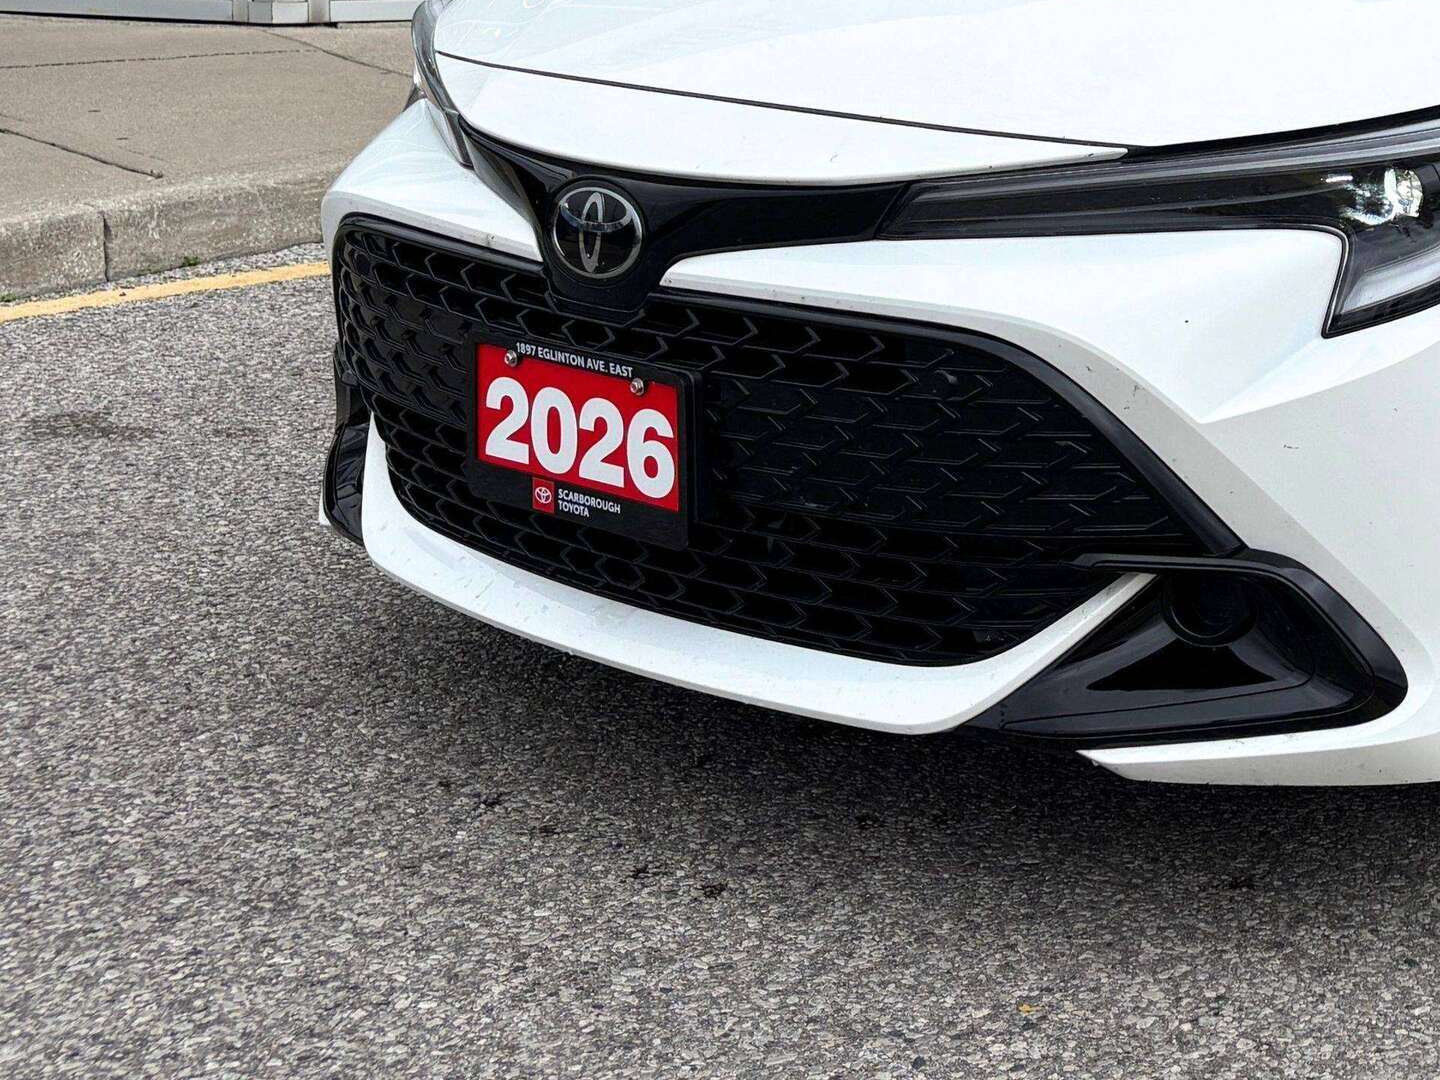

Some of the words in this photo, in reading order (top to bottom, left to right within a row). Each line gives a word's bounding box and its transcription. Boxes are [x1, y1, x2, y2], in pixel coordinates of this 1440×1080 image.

[516, 342, 536, 356] 1897
[537, 347, 585, 368] EGLINTON
[586, 358, 608, 373] AVE.
[609, 362, 633, 378] EAST
[485, 376, 675, 499] 2026
[558, 488, 621, 514] SCARBOROUGH
[558, 500, 590, 518] TOYOTA
